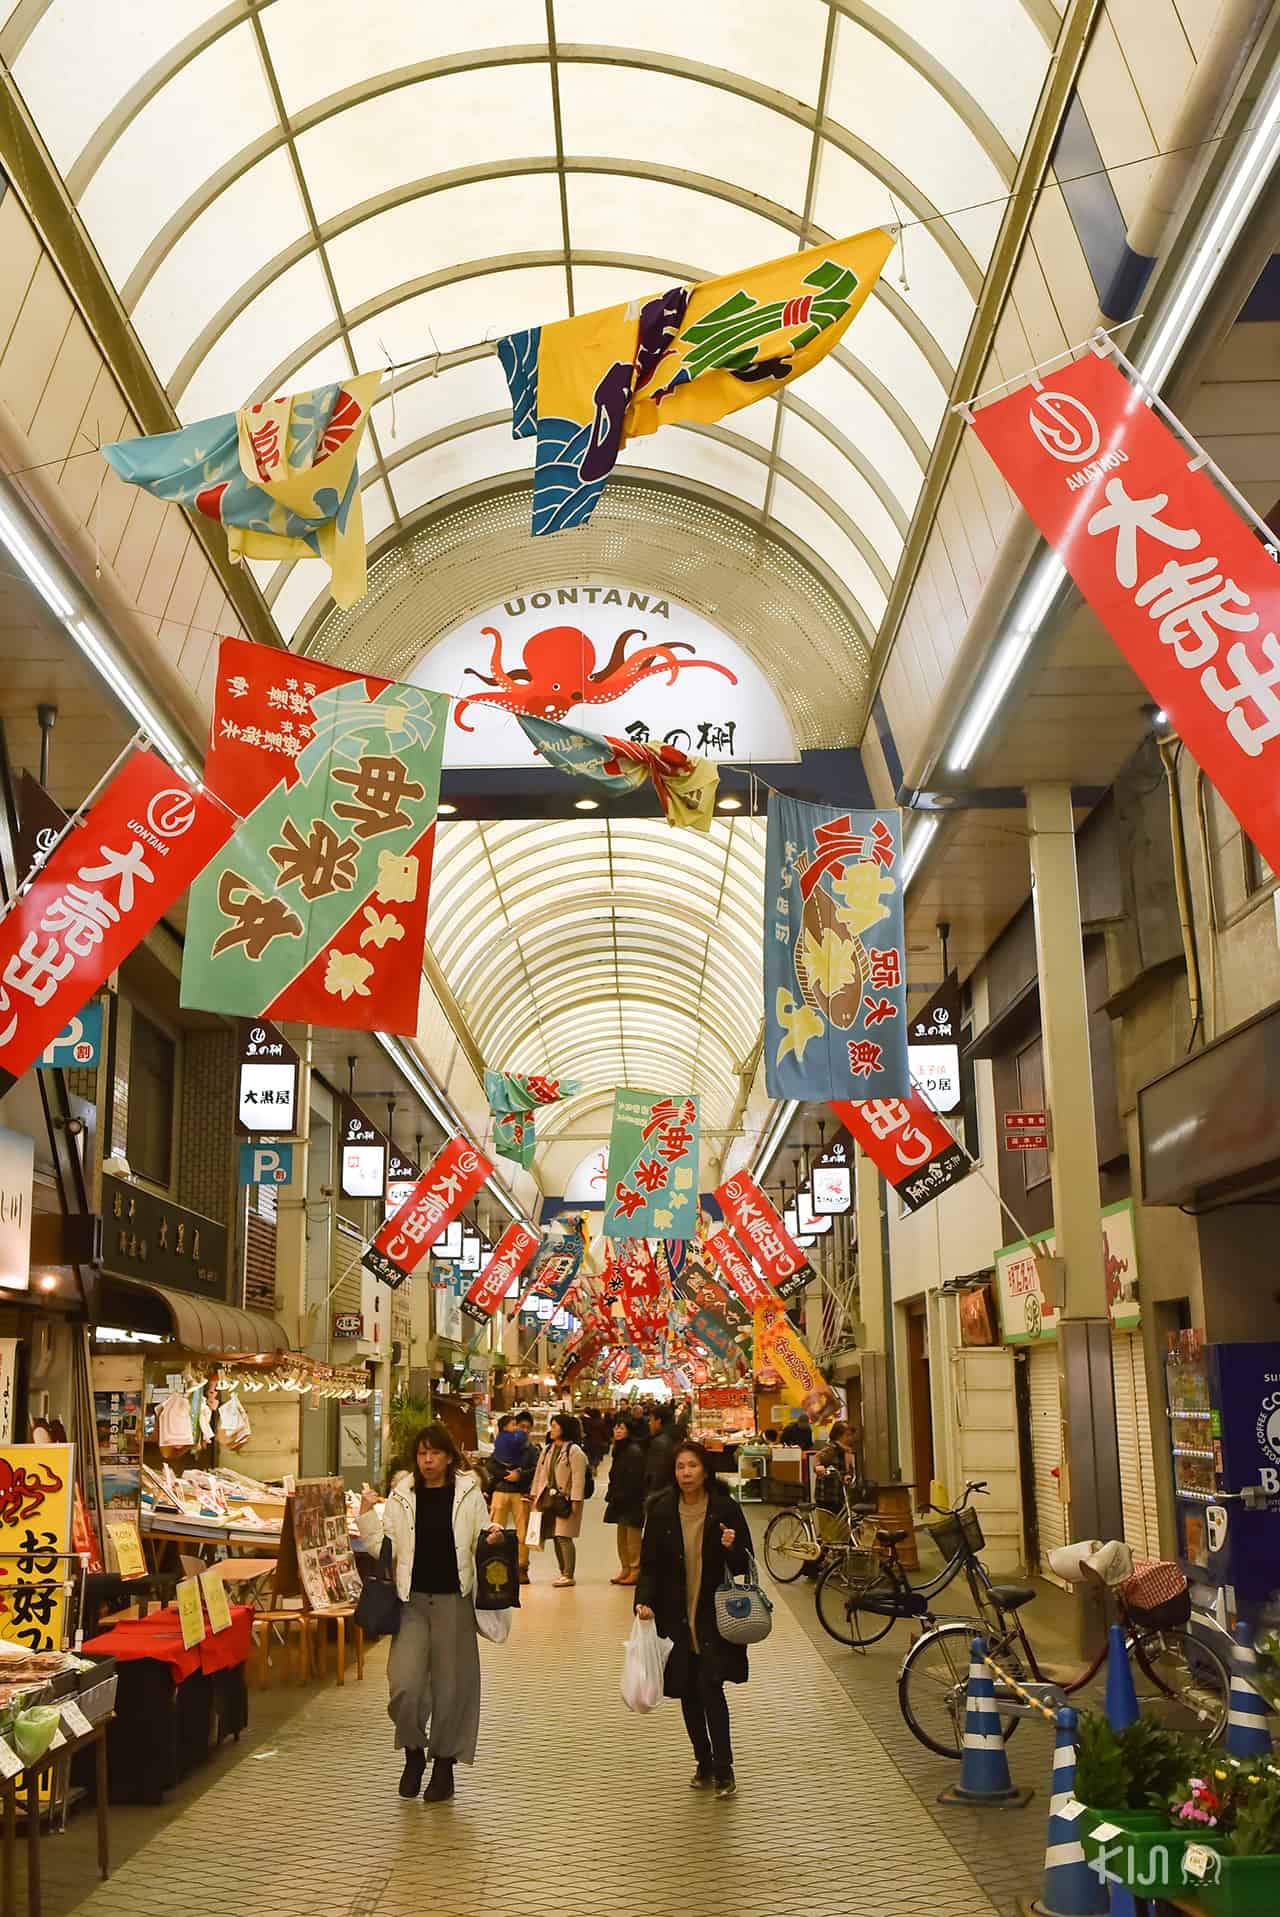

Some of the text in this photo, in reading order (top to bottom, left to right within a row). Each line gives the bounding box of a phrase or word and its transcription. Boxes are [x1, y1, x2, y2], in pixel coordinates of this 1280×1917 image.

[503, 587, 671, 619] UONTANA
[126, 818, 170, 857] UONTANA
[915, 1023, 952, 1037] 魚の棚
[245, 1043, 283, 1057] 魚の棚
[243, 1089, 290, 1105] 大黒屋
[252, 1149, 280, 1183] P
[385, 1172, 463, 1261] 大売出し
[475, 1247, 521, 1307] 大売出し
[336, 1316, 361, 1329] たばこ
